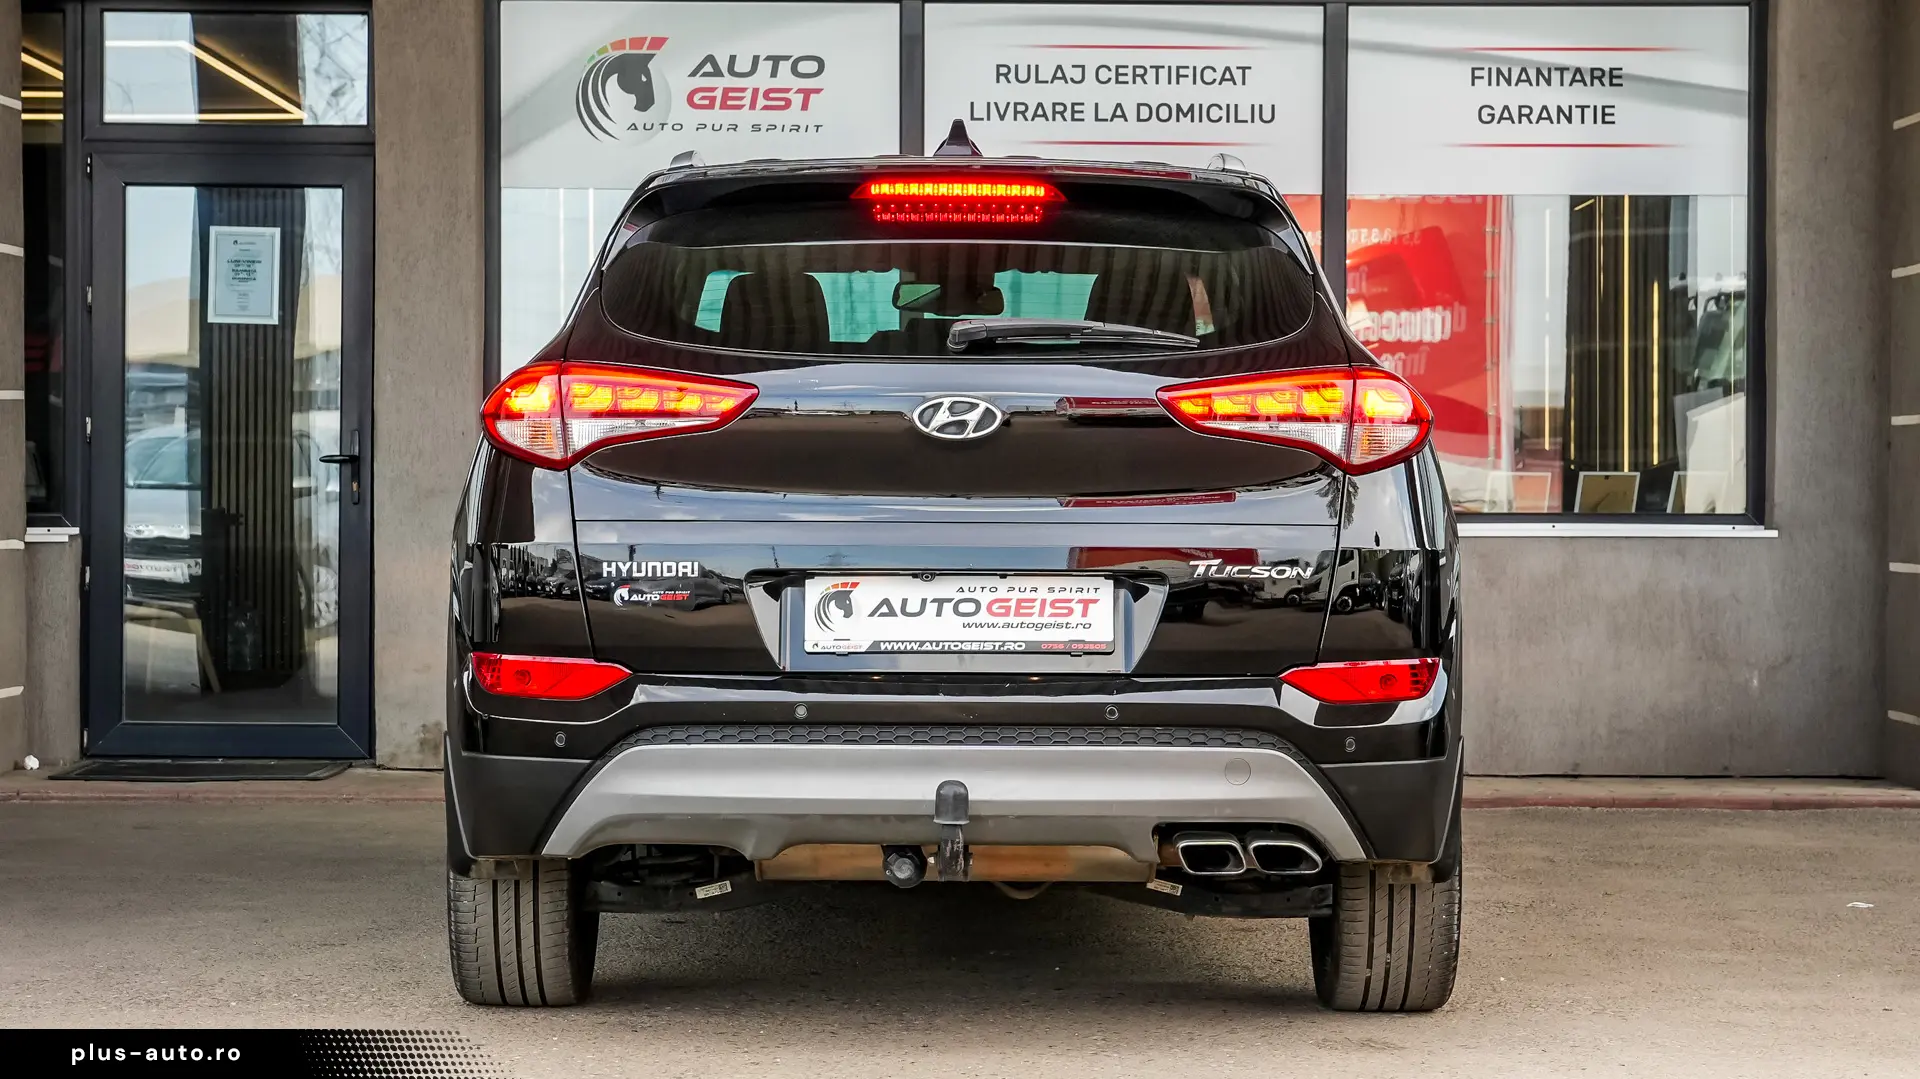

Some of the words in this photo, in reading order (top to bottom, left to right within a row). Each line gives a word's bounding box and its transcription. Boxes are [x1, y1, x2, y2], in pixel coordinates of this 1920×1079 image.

[687, 54, 826, 79] AUTO
[995, 63, 1086, 85] RULAJ
[1094, 64, 1252, 86] CERTIFICAT
[1470, 66, 1624, 88] FINANTARE
[686, 86, 825, 111] GEIST
[969, 101, 1085, 122] LIVRARE
[1094, 102, 1128, 123] LA
[1136, 103, 1277, 124] DOMICILIU
[1477, 104, 1616, 125] GARANTIE
[626, 122, 684, 132] AUTO
[695, 123, 738, 132] PUR
[750, 123, 824, 133] SPIRIT
[602, 561, 699, 578] HYUNDAI
[956, 586, 998, 594] AUTO
[1007, 586, 1039, 594] PUR
[1047, 586, 1101, 595] SPIRIT
[867, 597, 1101, 618] AUTOGEIST
[962, 620, 1092, 632] www.autogeist.ro
[880, 641, 1026, 651] WWW.AUTOGEIST.RO
